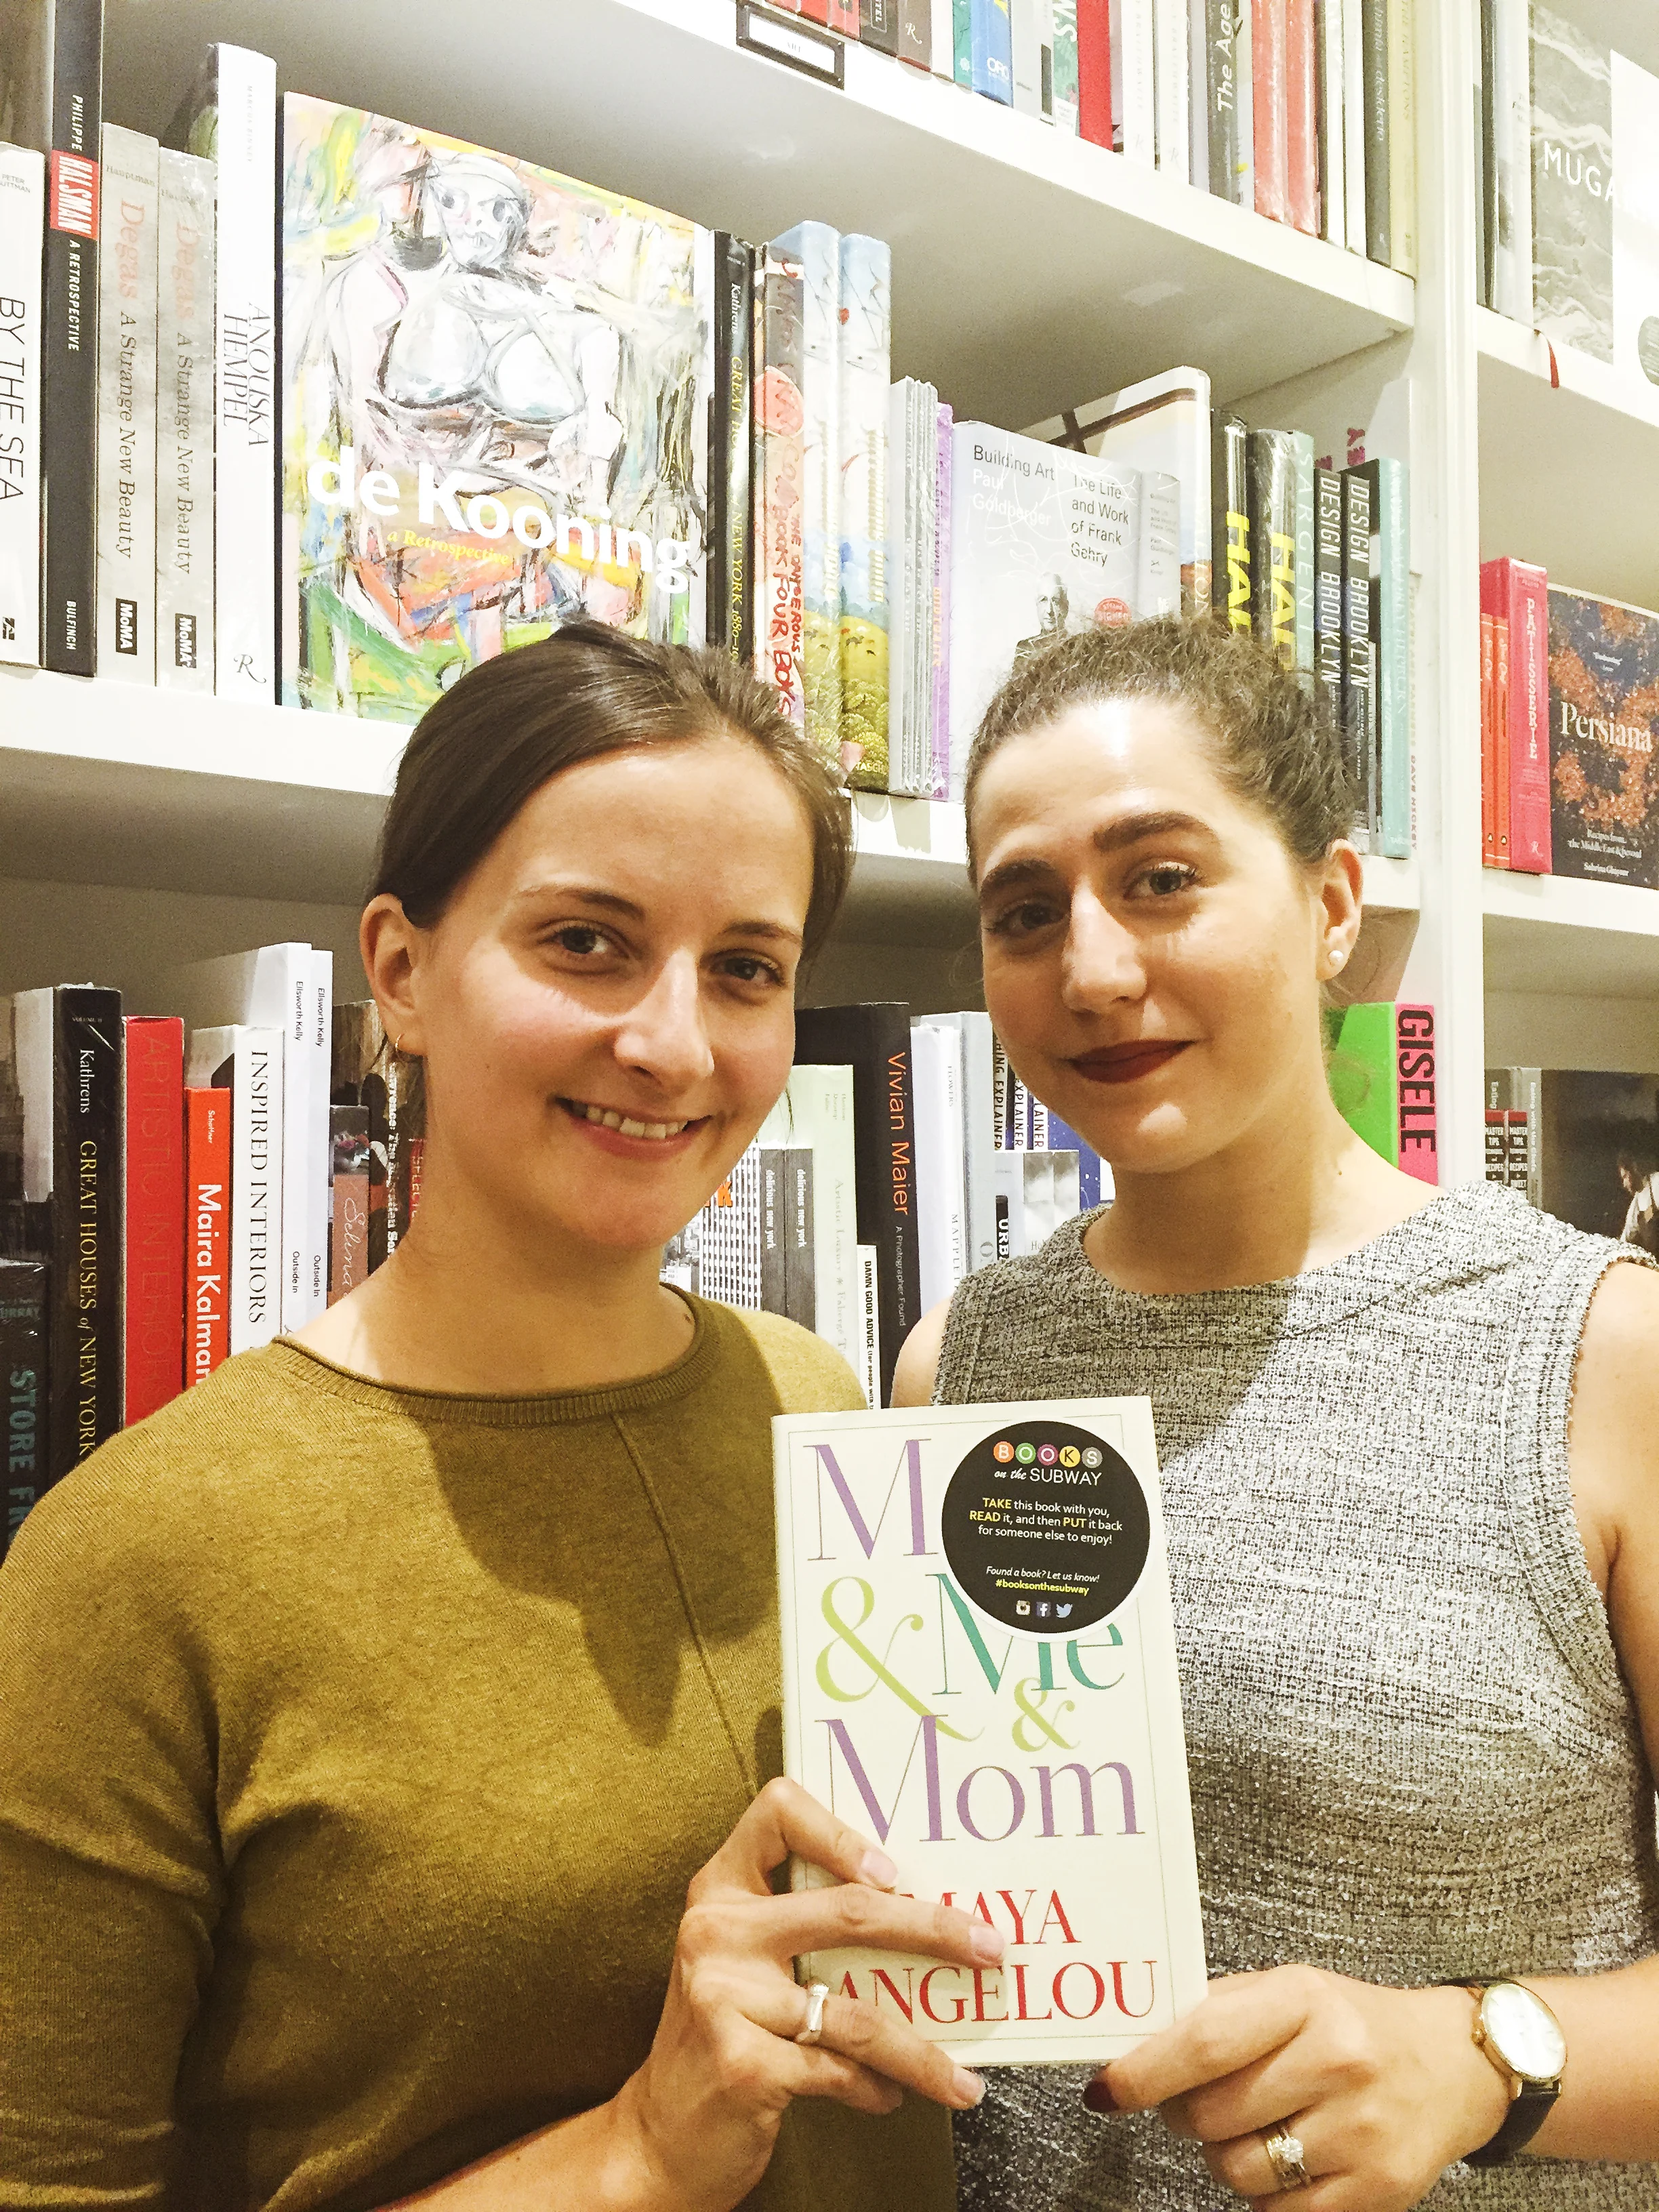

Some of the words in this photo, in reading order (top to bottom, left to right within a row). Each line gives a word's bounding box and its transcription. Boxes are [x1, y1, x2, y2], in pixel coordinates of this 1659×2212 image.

[1215, 3, 1235, 58] Age
[1216, 64, 1233, 112] The
[71, 94, 83, 152] PHILIPPE
[1, 174, 26, 186] PETER
[57, 155, 94, 235] HALSMAN
[68, 239, 81, 249] A
[113, 199, 145, 300] Degas
[171, 222, 201, 320] Degas
[0, 297, 25, 347] BY
[67, 251, 81, 352] RETROSPECTIVE
[119, 311, 138, 327] A
[730, 283, 742, 335] Kathrens
[176, 332, 192, 347] A
[0, 357, 25, 424] THE
[116, 335, 138, 422] Strange
[222, 313, 248, 427] HEMPEL
[247, 302, 271, 447] ANOUSKA
[731, 356, 743, 414] GREAT
[173, 356, 194, 441] Strange
[0, 436, 24, 500] SEA
[118, 426, 136, 475] New
[176, 445, 194, 493] New
[973, 445, 1031, 476] Building
[1035, 462, 1054, 481] Art
[972, 468, 1005, 489] Paul
[1073, 475, 1095, 493] The
[1100, 480, 1122, 499] Life
[115, 480, 136, 559] Beauty
[175, 496, 195, 575] Beauty
[307, 446, 400, 517] de
[417, 462, 692, 594] Kooning
[731, 512, 743, 558] NEW
[972, 493, 1051, 527] Goldberger
[1071, 497, 1095, 513] and
[1098, 500, 1130, 525] Work
[1071, 520, 1084, 533] of
[1088, 523, 1122, 546] Frank
[1320, 476, 1341, 558] DESIGN
[1350, 483, 1370, 565] DESIGN
[387, 531, 398, 543] a
[403, 529, 510, 565] Retrospective
[772, 504, 790, 568] BOOK
[1071, 542, 1108, 567] Gehry
[1296, 449, 1314, 638] SARGENT
[731, 558, 743, 605] YORK
[772, 571, 792, 639] FOUR
[66, 600, 77, 651] BULFINCH
[118, 602, 134, 650] MoMA
[178, 616, 196, 665] MoMA
[1320, 571, 1342, 684] BROOKLYN
[1350, 577, 1370, 689] BROOKLYN
[773, 649, 796, 718] BOYS
[1526, 597, 1538, 760] PATISSERIE
[1560, 700, 1654, 754] Persiana
[295, 981, 304, 1020] Ellsworth
[293, 1021, 303, 1042] Kelly
[315, 1027, 324, 1048] Kelly
[79, 1049, 95, 1114] Kathrens
[888, 1052, 907, 1130] Vivian
[1397, 1009, 1437, 1153] GISELE
[1490, 1081, 1499, 1109] Eating
[250, 1051, 268, 1171] INSPIRED
[994, 1080, 1006, 1150] EXPLAINER
[79, 1140, 98, 1215] GREAT
[766, 1168, 775, 1208] delirious
[796, 1168, 806, 1207] delirious
[891, 1141, 909, 1216] Maier
[197, 1184, 222, 1267] Maira
[764, 1228, 777, 1249] york
[766, 1210, 775, 1227] new
[796, 1209, 805, 1227] new
[796, 1227, 807, 1248] york
[79, 1222, 98, 1309] HOUSES
[248, 1181, 268, 1324] INTERIORS
[292, 1250, 300, 1282] Outside
[313, 1254, 321, 1286] Outside
[864, 1261, 872, 1288] DAMN
[895, 1235, 905, 1296] Photographer
[313, 1287, 320, 1298] In
[865, 1290, 874, 1315] GOOD
[897, 1297, 907, 1327] Found
[77, 1317, 89, 1332] of
[195, 1274, 221, 1384] Kalman
[865, 1317, 874, 1349] ADVICE
[79, 1336, 97, 1389] NEW
[9, 1368, 37, 1473] STORE
[79, 1396, 97, 1456] YORK
[994, 1470, 1006, 1479] on
[1010, 1467, 1027, 1480] the
[1029, 1467, 1103, 1486] SUBWAY
[995, 1442, 1101, 1467] BOOKS
[969, 1510, 1001, 1523] READ
[1002, 1512, 1013, 1525] it,
[1015, 1513, 1035, 1525] and
[1037, 1515, 1061, 1527] then
[1063, 1517, 1087, 1529] PUT
[1088, 1519, 1097, 1530] it
[1098, 1519, 1123, 1532] back
[983, 1496, 1012, 1510] TAKE
[1013, 1498, 1033, 1511] this
[1035, 1500, 1061, 1513] book
[1063, 1504, 1086, 1515] with
[1088, 1506, 1110, 1518] you,
[978, 1524, 994, 1536] for
[995, 1528, 1043, 1540] someone
[1044, 1530, 1065, 1542] else
[1067, 1532, 1079, 1542] to
[1080, 1534, 1113, 1547] enjoy!
[985, 1565, 1013, 1577] Found
[1013, 1568, 1020, 1577] a
[1021, 1568, 1047, 1579] book?
[1047, 1570, 1062, 1581] Let
[1063, 1573, 1073, 1582] us
[1073, 1572, 1100, 1584] know!
[995, 1578, 1090, 1597] #booksonthesubway
[815, 1575, 986, 1742] &
[925, 1573, 1126, 1696] Me
[1011, 1677, 1081, 1753] &
[814, 1714, 1145, 1846] Mom
[899, 1889, 1082, 1946] AYA
